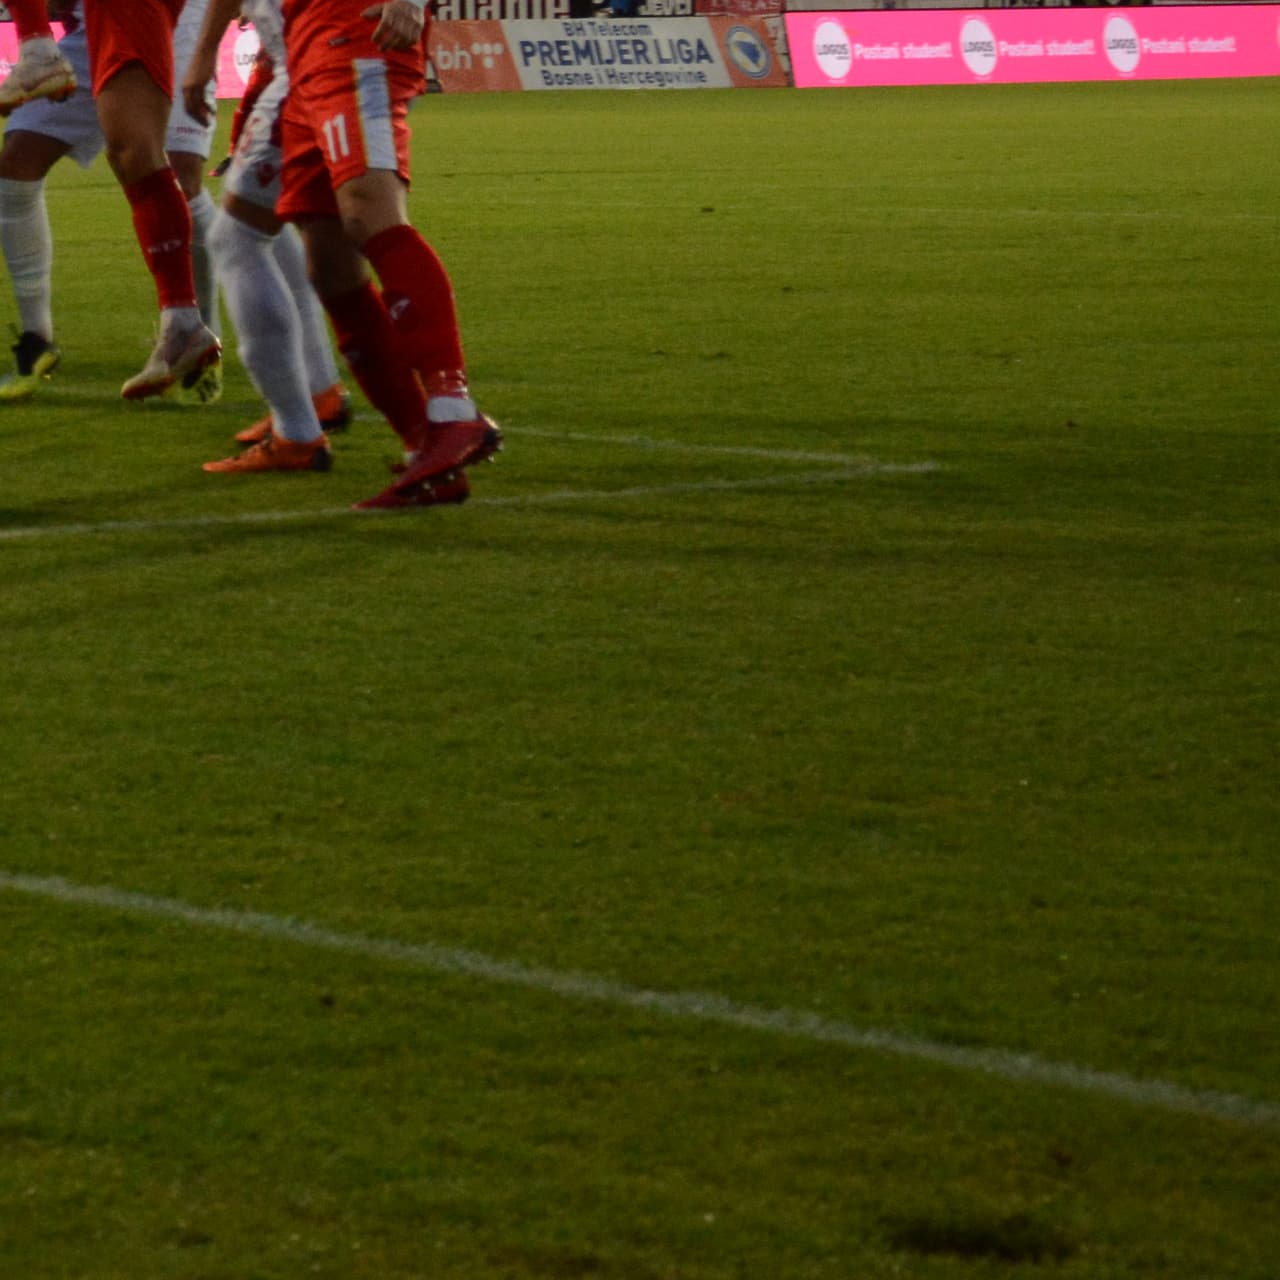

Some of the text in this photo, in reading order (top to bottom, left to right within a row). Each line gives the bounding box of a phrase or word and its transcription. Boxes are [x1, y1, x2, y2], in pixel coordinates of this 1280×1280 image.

[562, 21, 652, 37] BH Telecom
[436, 42, 472, 70] bh
[520, 38, 713, 66] PREMIJER LIGA
[541, 69, 593, 86] Bosne
[605, 67, 707, 87] Hercegovine
[322, 114, 351, 164] 11
